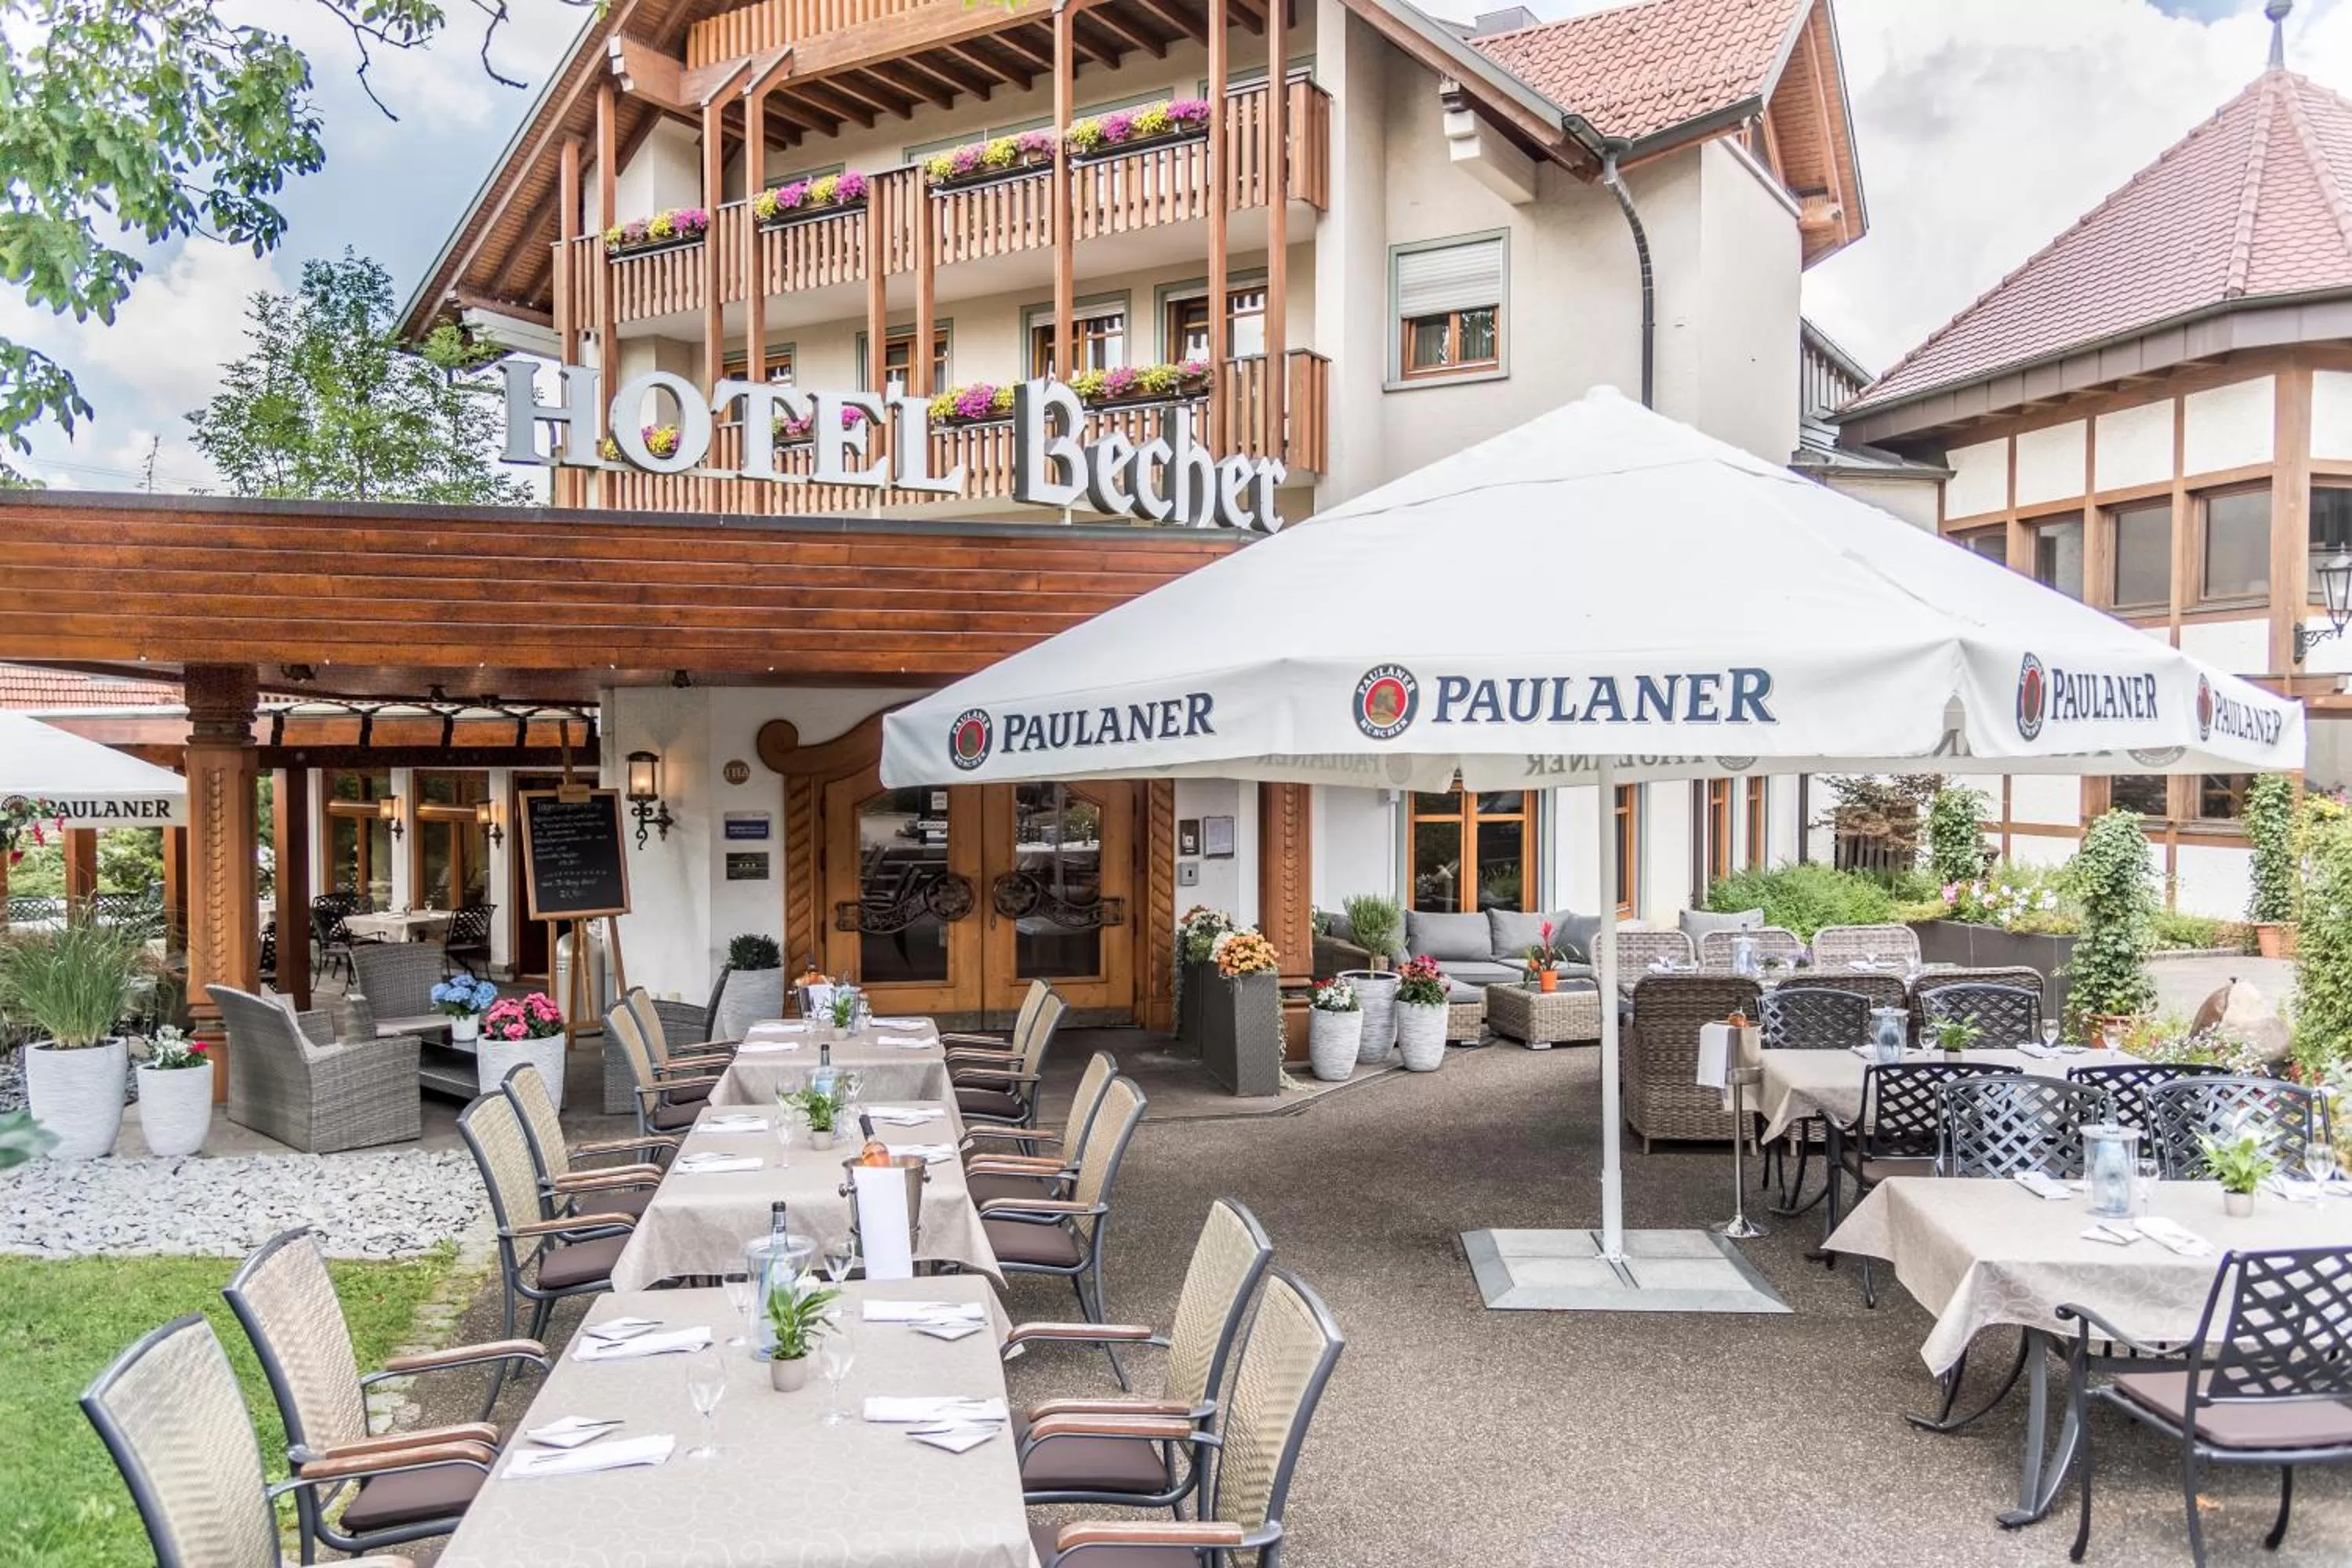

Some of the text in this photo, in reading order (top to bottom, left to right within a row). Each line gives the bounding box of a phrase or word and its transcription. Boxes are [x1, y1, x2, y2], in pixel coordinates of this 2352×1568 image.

[498, 359, 1287, 535] HOTEL Becher
[1356, 666, 1416, 695] PAULANER
[1432, 667, 1779, 724] PAULANER
[2050, 668, 2158, 721] PAULANER
[1000, 691, 1215, 753] PAULANER
[2214, 689, 2282, 746] PAULANER
